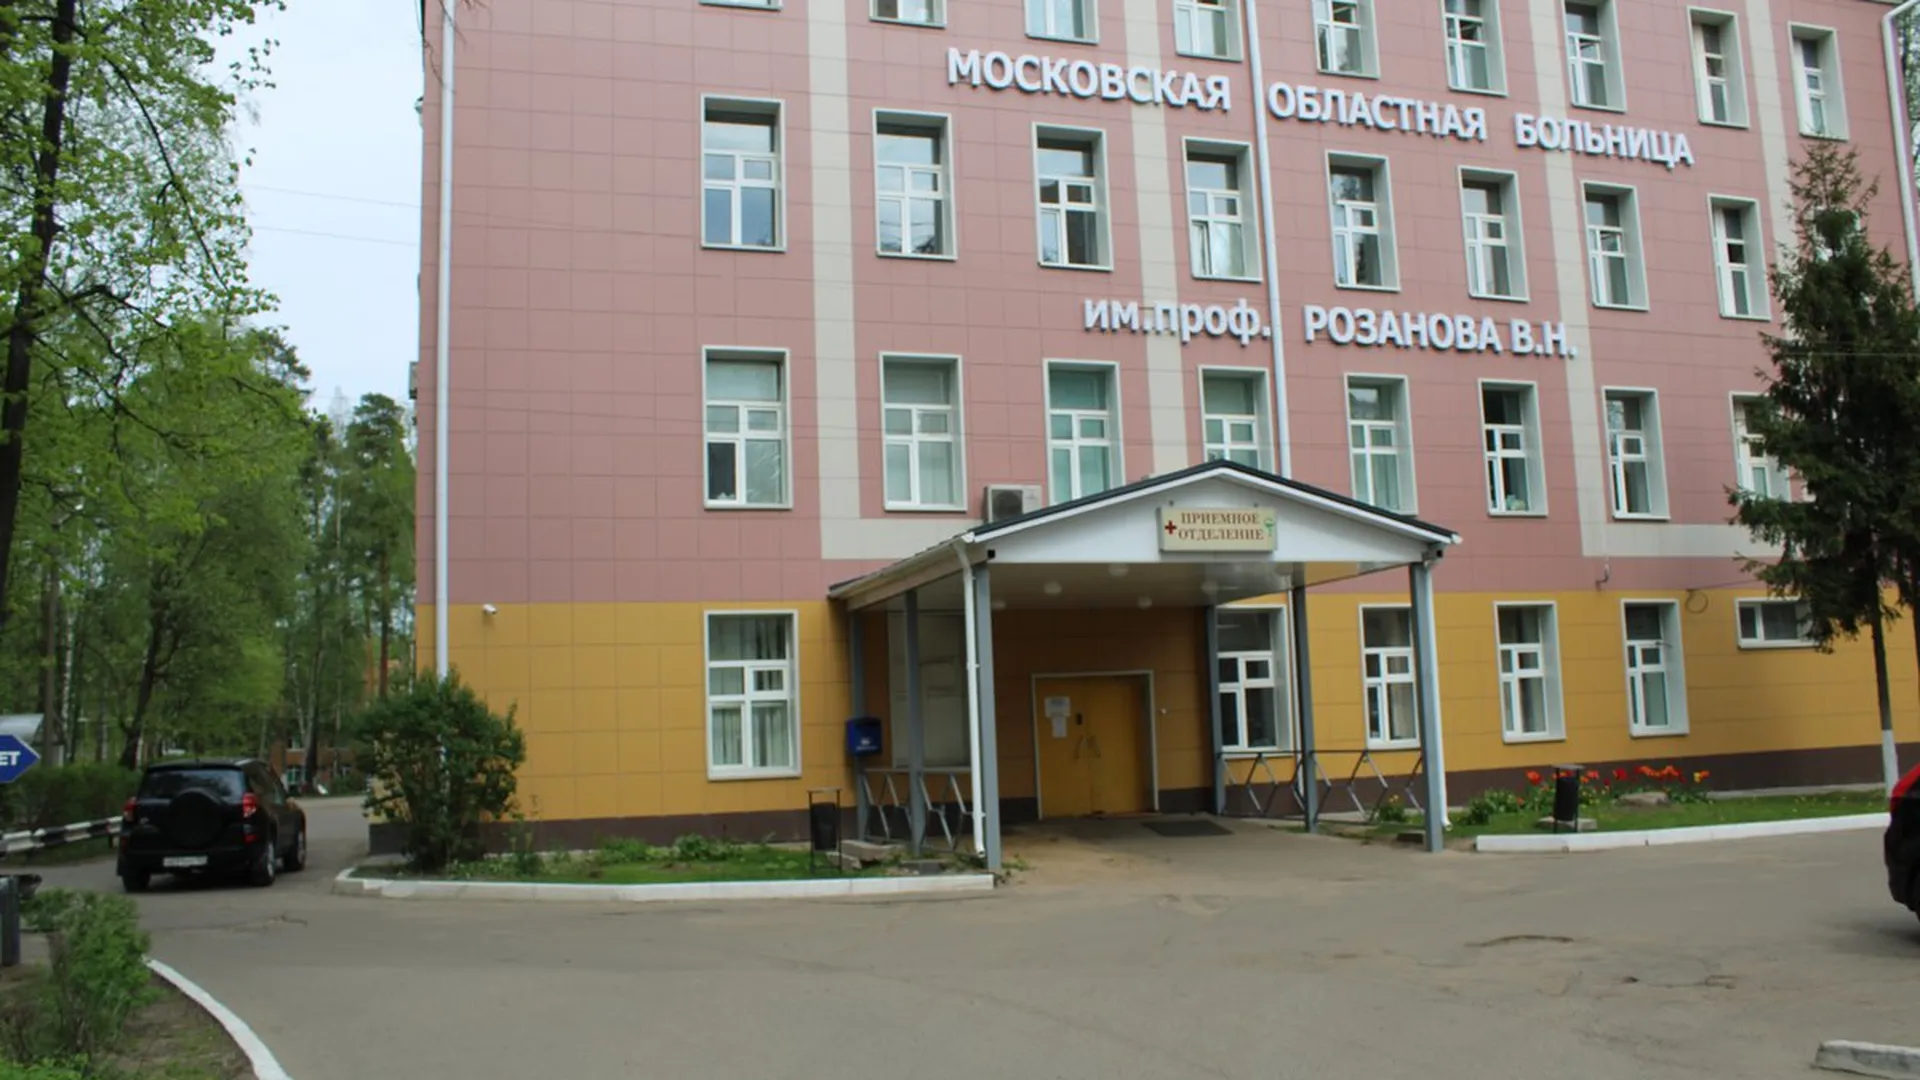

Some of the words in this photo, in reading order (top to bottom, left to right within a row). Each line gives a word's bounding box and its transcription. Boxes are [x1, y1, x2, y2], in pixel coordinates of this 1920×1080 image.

[947, 47, 1231, 112] МОСКОВСКАЯ
[1267, 81, 1488, 142] ОБЛАСТНАЯ
[1514, 112, 1696, 170] БОЛЬНИЦА
[1303, 304, 1501, 352] РОЗАНОВА
[1510, 316, 1579, 359] В.Н.
[1178, 528, 1264, 541] ОТДЕЛЕНИЕ
[1180, 512, 1259, 525] ПРИЕМНОЕ
